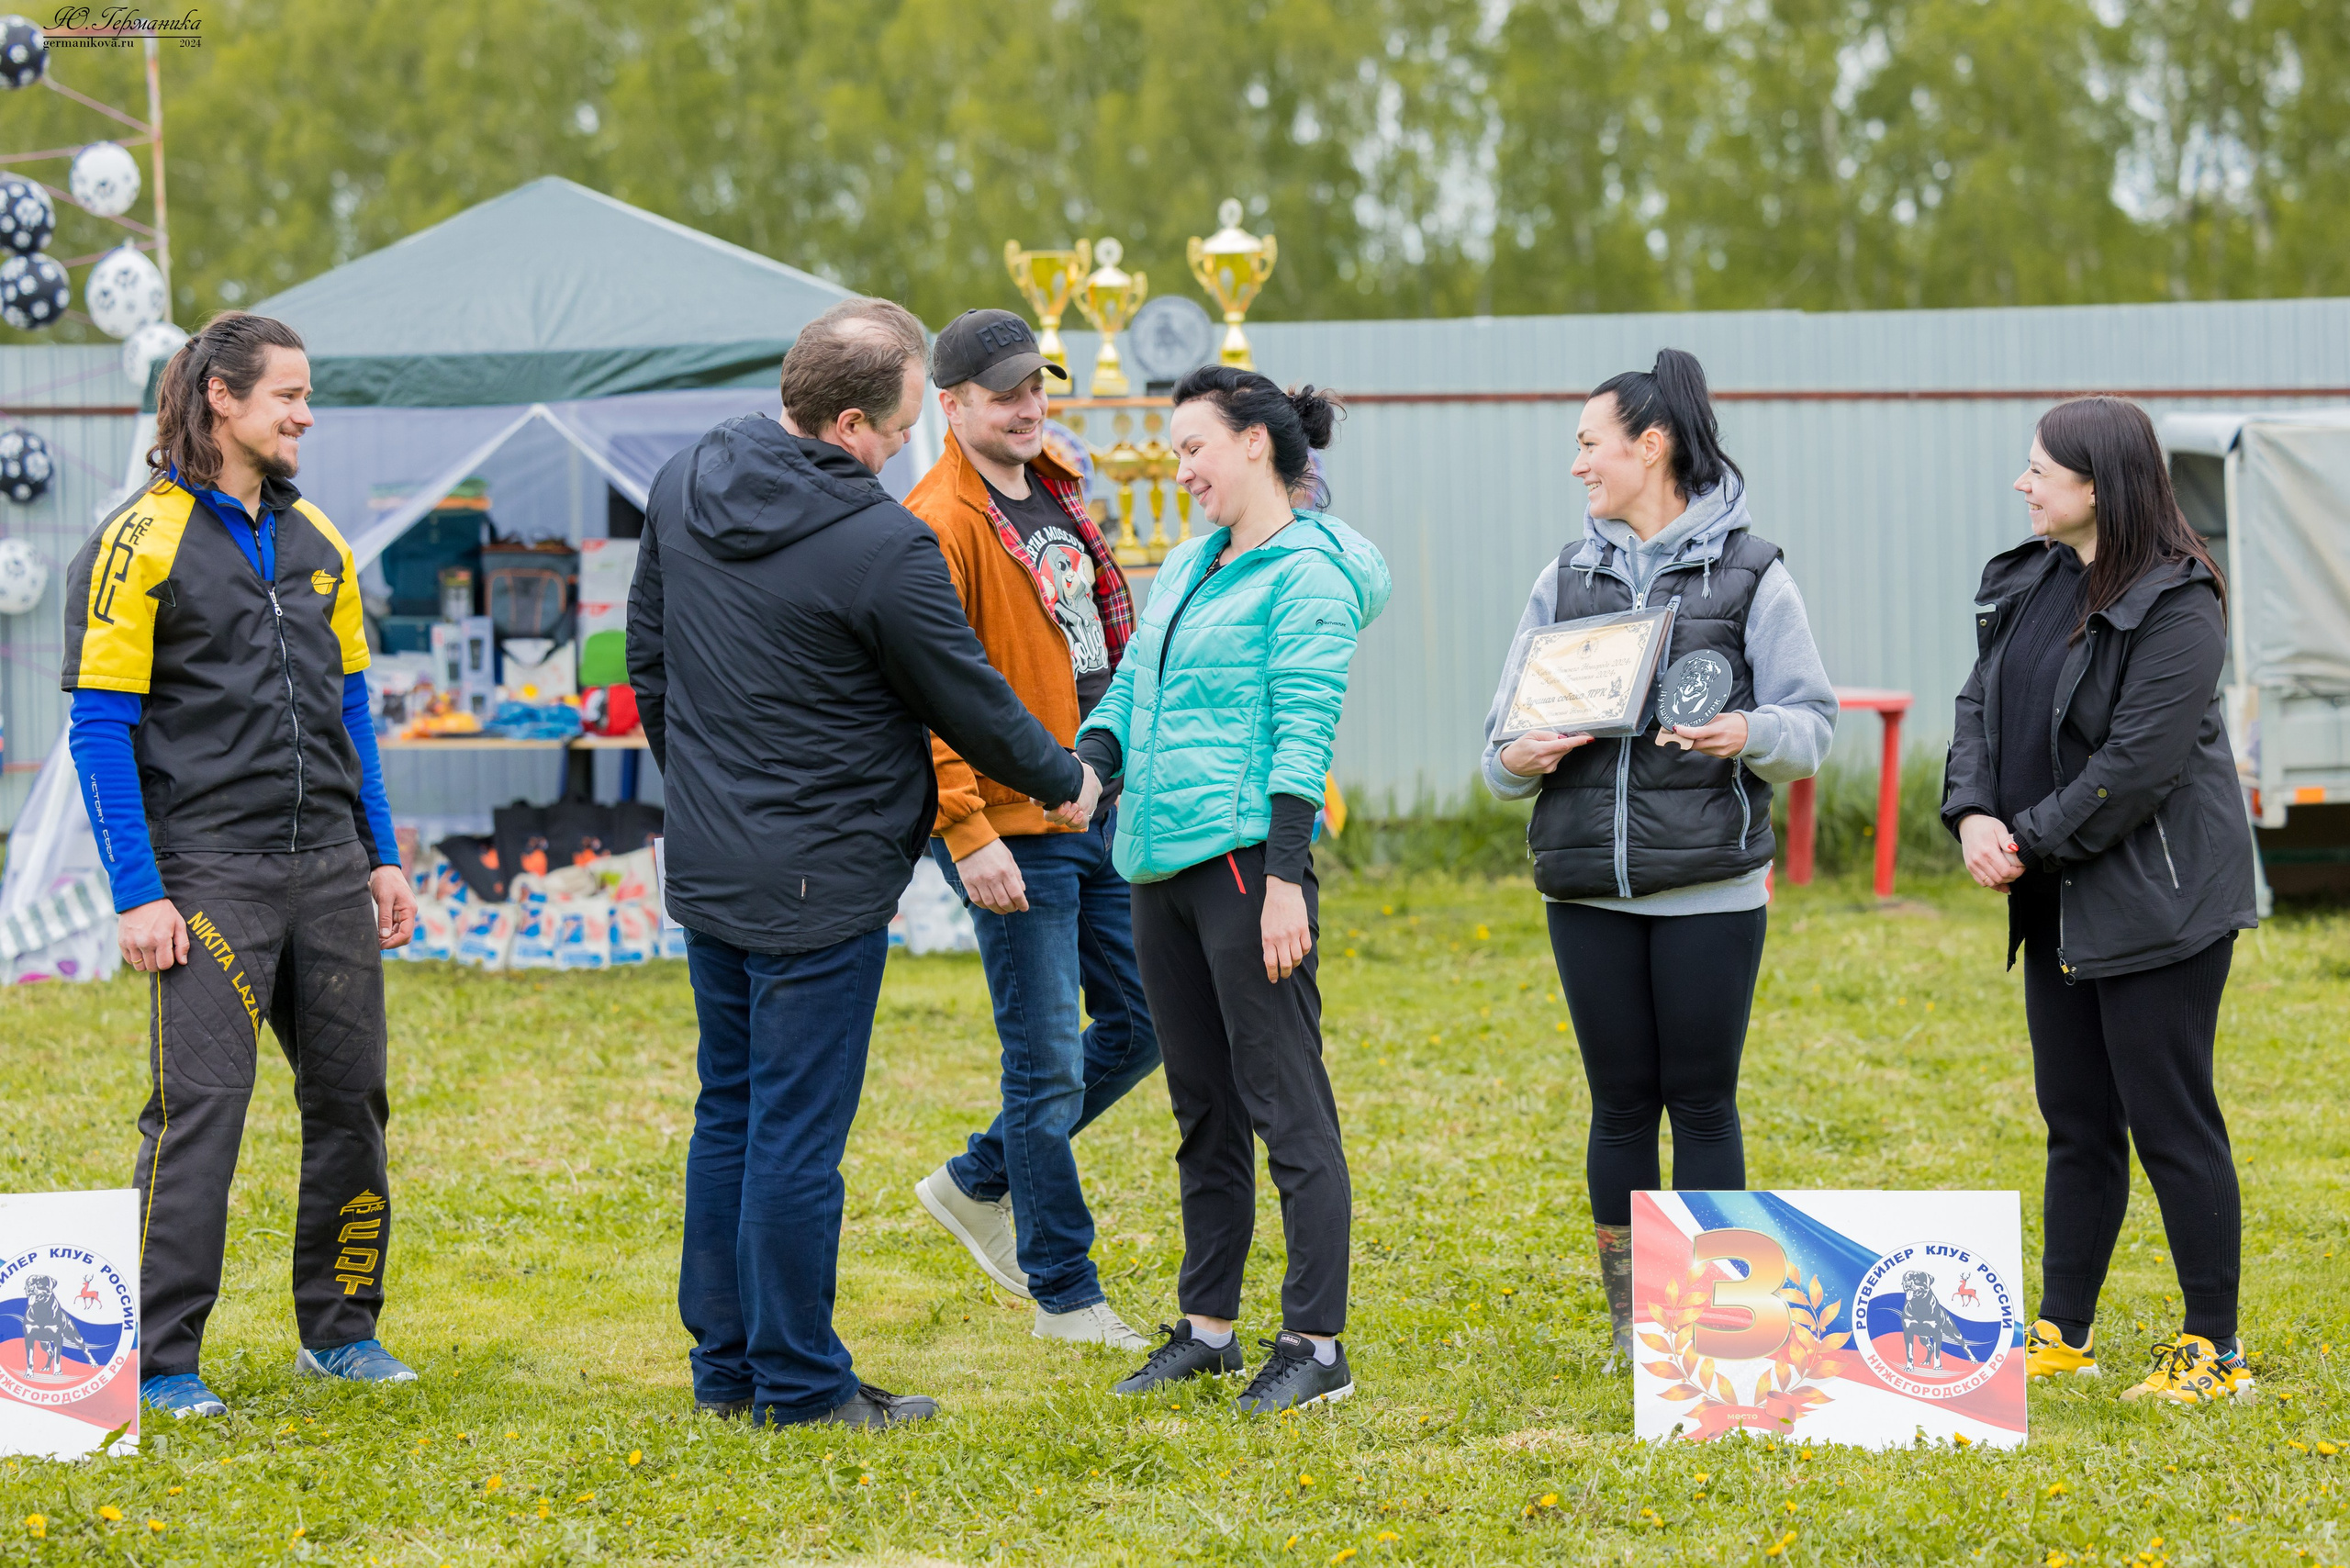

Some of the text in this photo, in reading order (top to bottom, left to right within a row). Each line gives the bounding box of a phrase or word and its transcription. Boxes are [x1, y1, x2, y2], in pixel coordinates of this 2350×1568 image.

[1043, 525, 1085, 553] MOSCOW
[90, 773, 116, 863] VICTORY CODE
[187, 911, 236, 971] NIKITA
[50, 1248, 95, 1265] КЛУБ
[100, 1264, 134, 1331] РОССИИ
[1693, 1227, 1792, 1361] 3
[1856, 1245, 2012, 1330] РОТВЕЙЛЕР КЛУБ РОССИИ
[0, 1355, 125, 1404] ЖЕГОРОДСКОЕ РО
[1867, 1353, 2005, 1398] НИЖЕГОРОДСКОЕ РО
